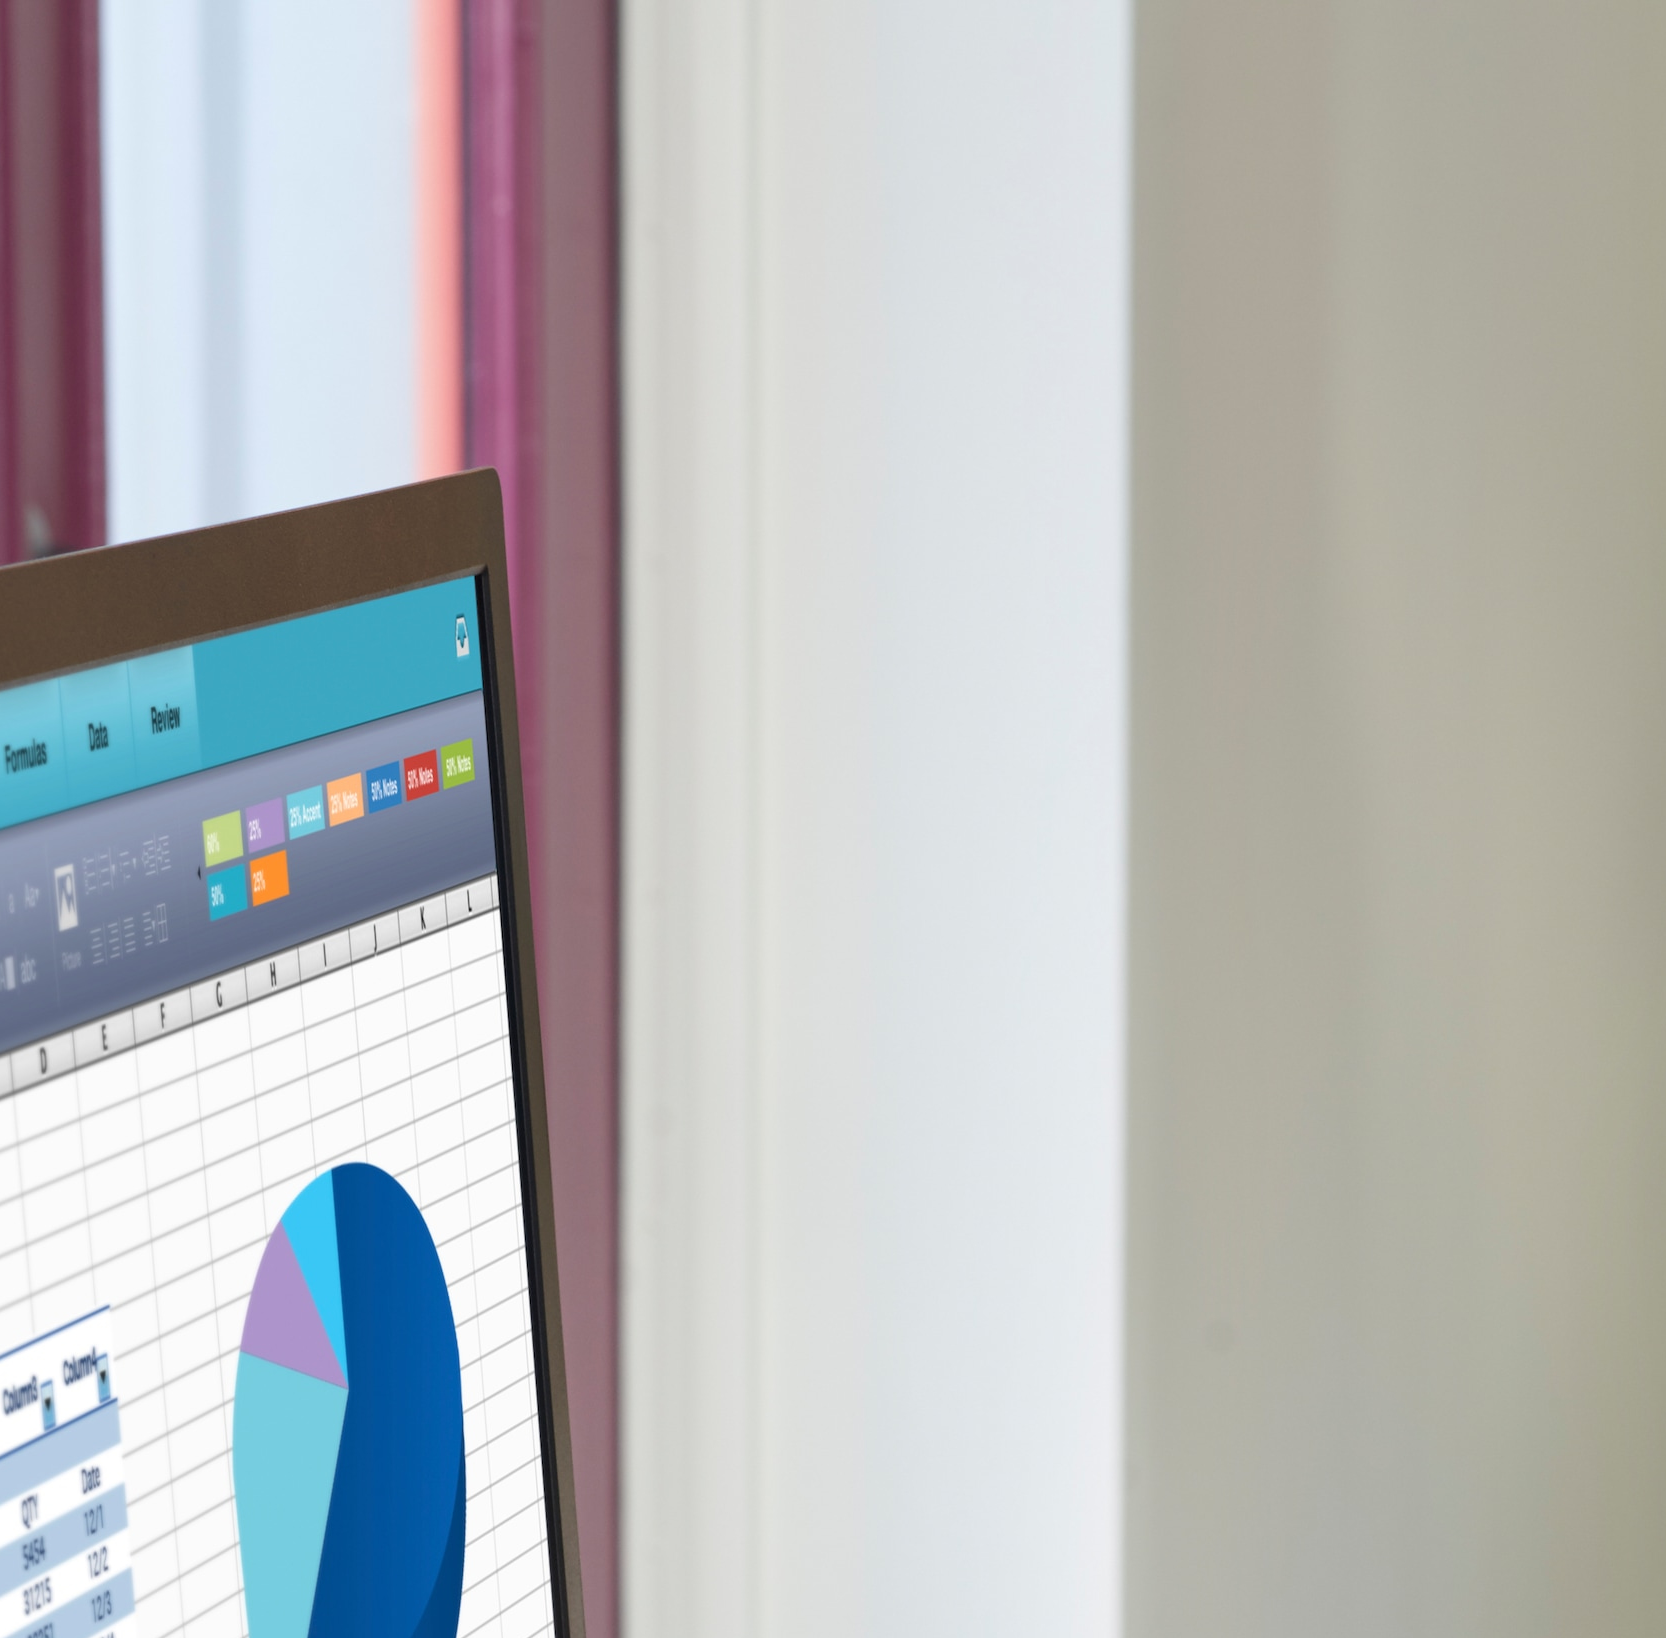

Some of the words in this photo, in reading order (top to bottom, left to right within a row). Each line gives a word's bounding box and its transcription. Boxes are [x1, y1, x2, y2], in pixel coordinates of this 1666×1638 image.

[150, 704, 180, 734] Review
[88, 722, 109, 751] Data
[5, 738, 48, 774] Formulas
[446, 758, 457, 777] 50%
[457, 755, 471, 773] Notes
[382, 778, 398, 798] Notes
[407, 769, 418, 790] 50%
[418, 766, 434, 786] Notes
[289, 805, 302, 827] 25%
[302, 801, 321, 824] Accent
[342, 790, 358, 811] Notes
[248, 819, 262, 841] 25%
[211, 884, 224, 907] 50%
[252, 871, 265, 892] 25%
[39, 1046, 48, 1075] D
[101, 1024, 109, 1051] E
[160, 1002, 167, 1029] F
[215, 982, 223, 1008] G
[269, 961, 277, 987] H
[373, 924, 378, 953] J
[419, 906, 426, 931] K
[466, 889, 472, 913] L
[2, 1375, 39, 1415] Column3
[63, 1346, 97, 1386] Column4
[21, 1494, 40, 1529] QTY
[81, 1466, 101, 1494] Date
[22, 1536, 46, 1571] 5454
[84, 1504, 104, 1537] 12/1
[23, 1577, 52, 1615] 31215
[88, 1547, 109, 1580] 12/2
[91, 1590, 112, 1623] 12/3
